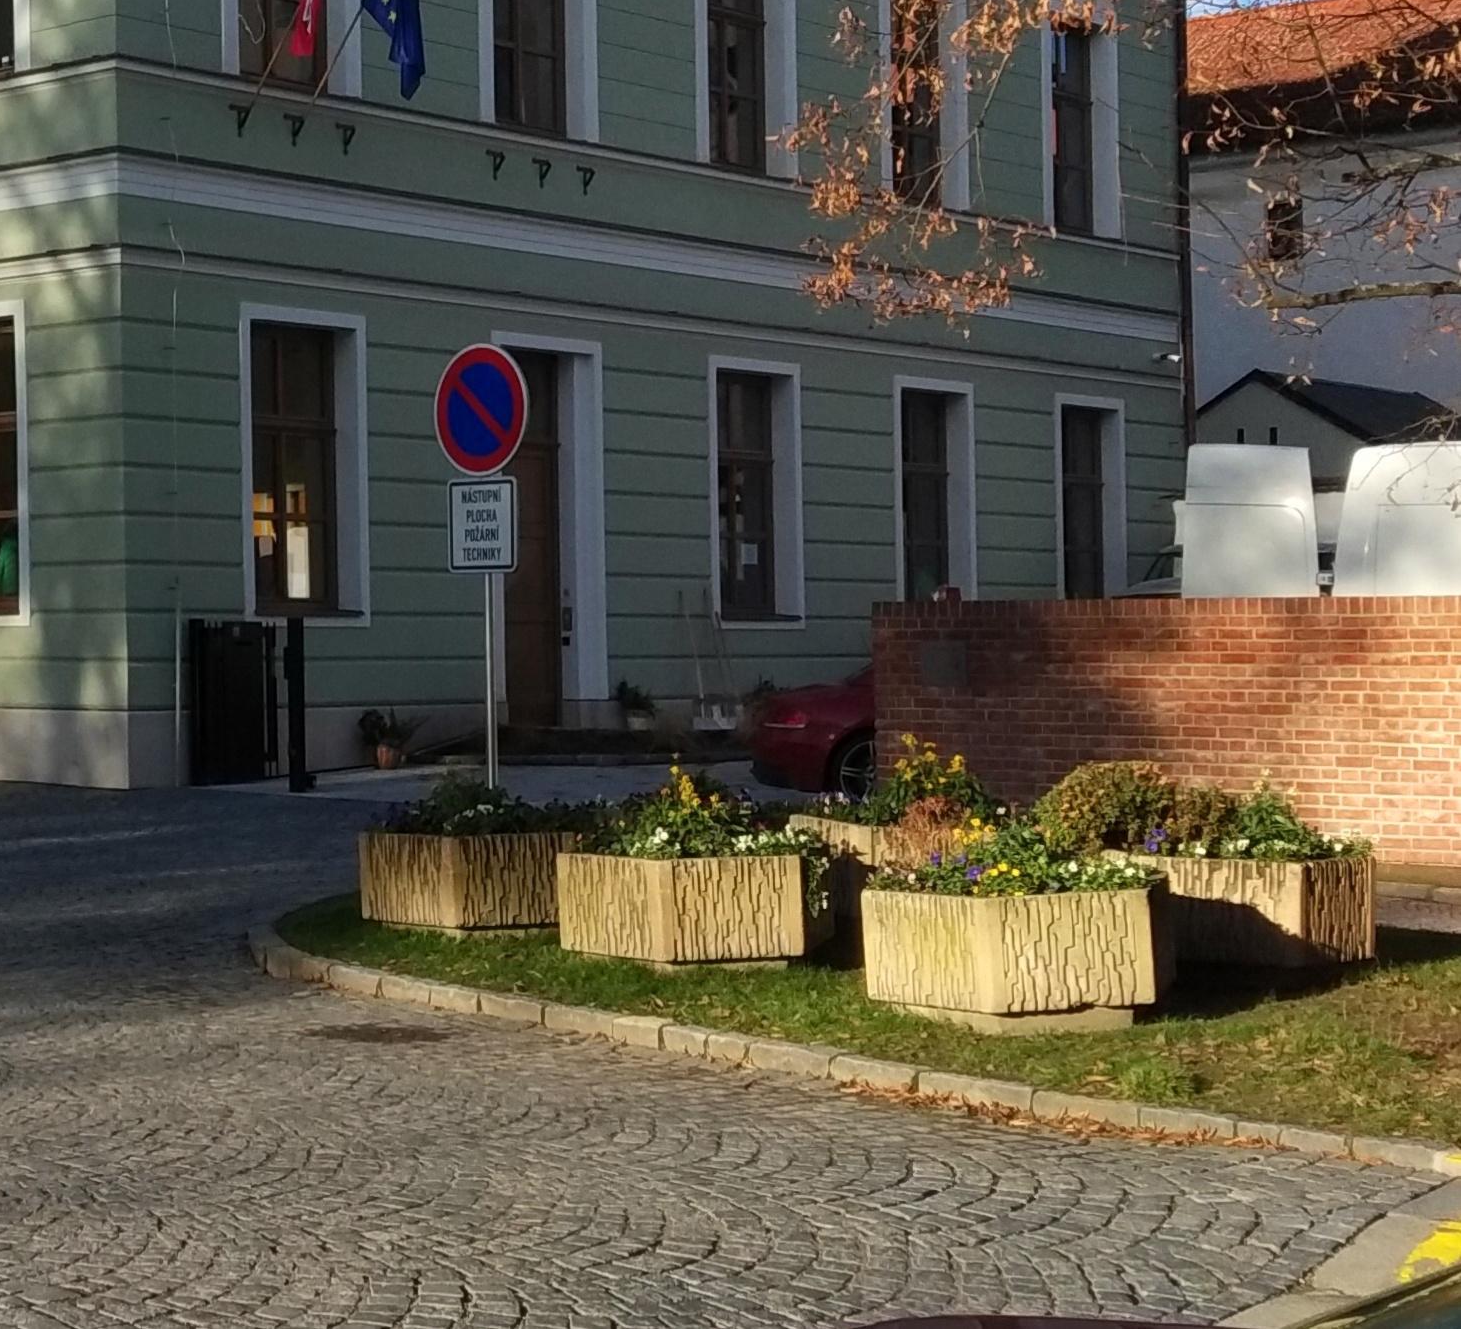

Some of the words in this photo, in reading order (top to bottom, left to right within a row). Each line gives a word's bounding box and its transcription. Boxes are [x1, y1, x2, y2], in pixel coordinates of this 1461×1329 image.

[461, 486, 502, 504] NÁSTUPNÍ
[466, 508, 498, 523] PLOCHA
[464, 525, 500, 543] POŽÁRNÍ
[462, 547, 502, 562] TECHNIKY
